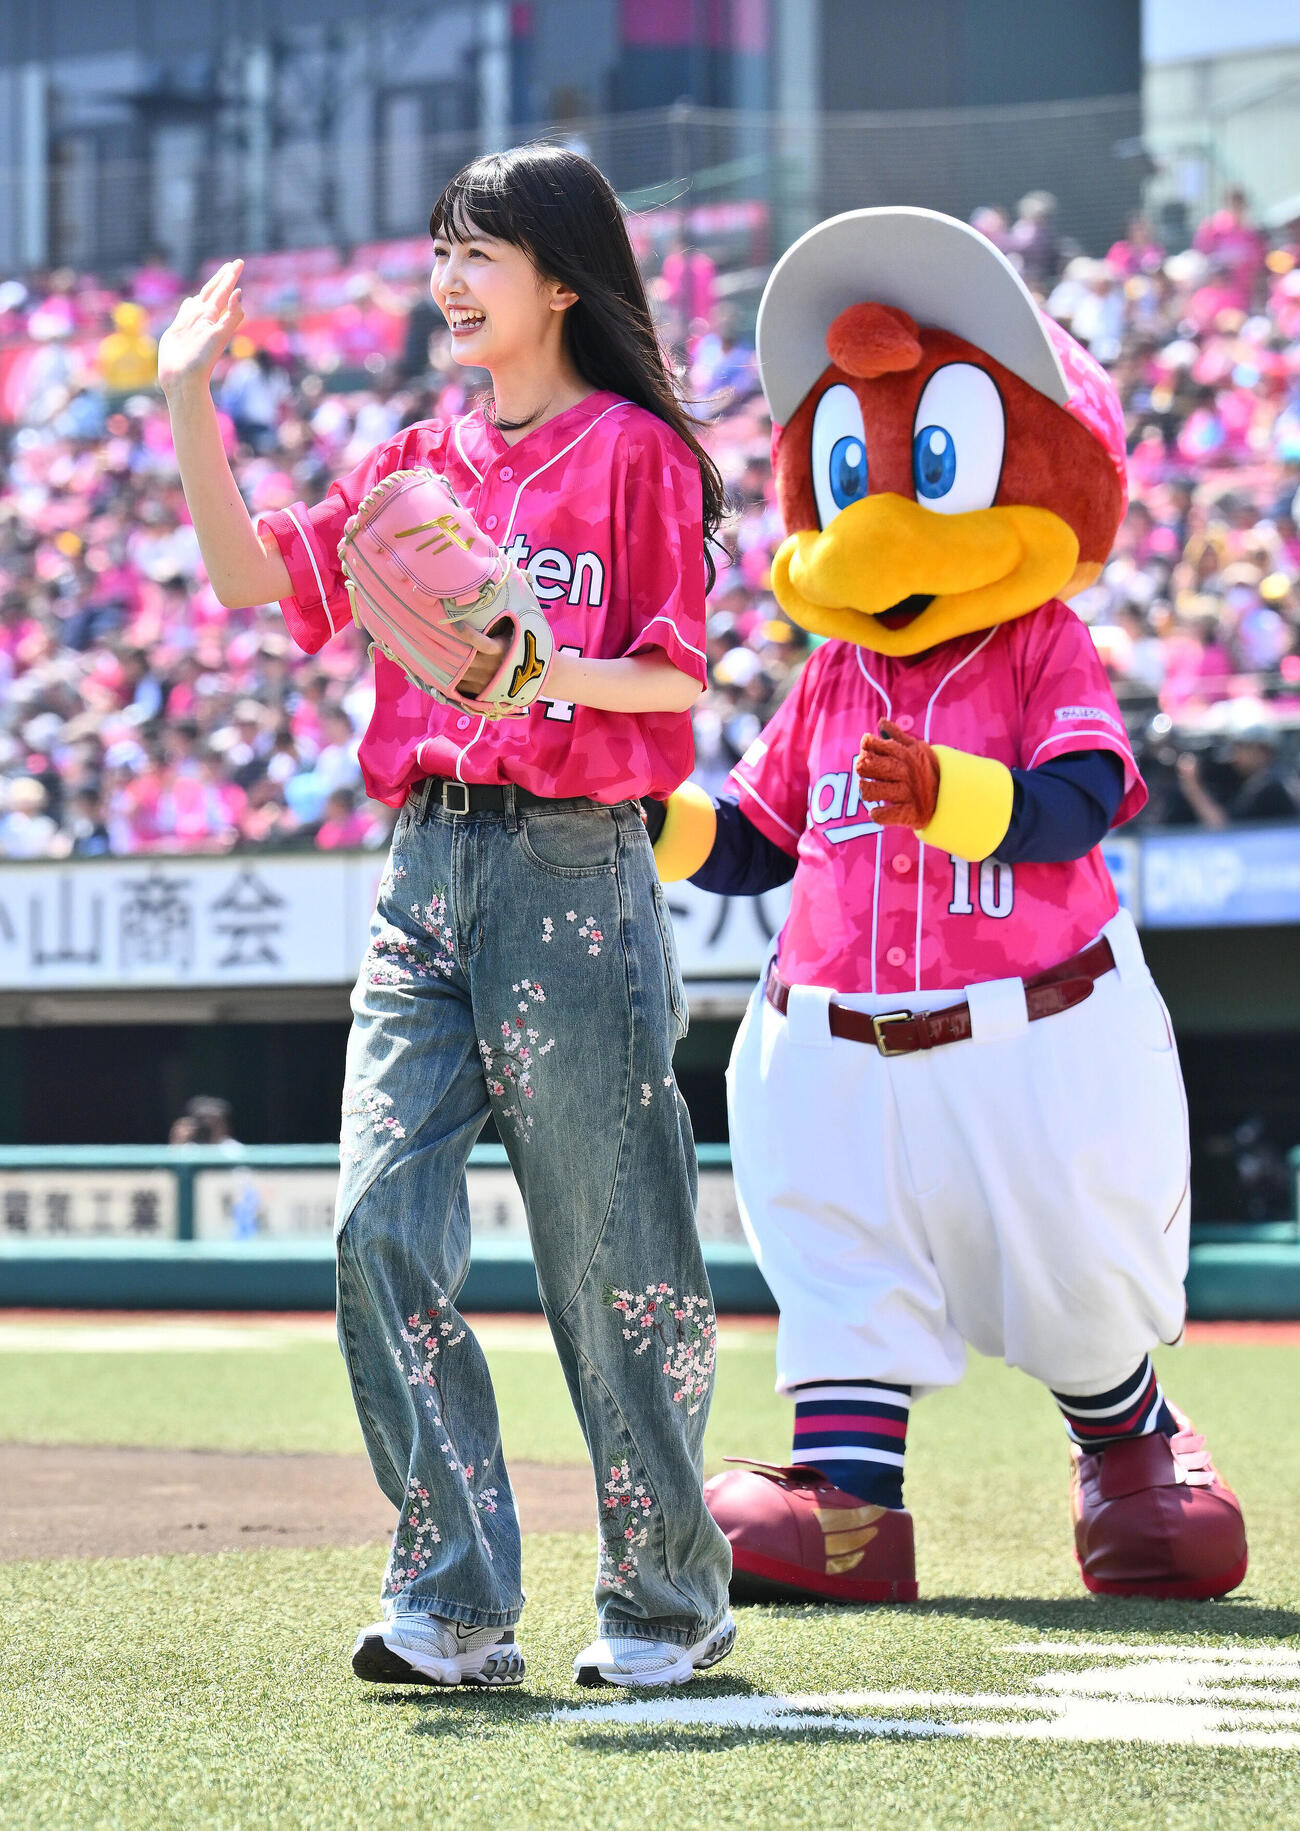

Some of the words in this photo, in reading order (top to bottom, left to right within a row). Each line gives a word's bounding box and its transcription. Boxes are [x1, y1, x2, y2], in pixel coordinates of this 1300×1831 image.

[501, 534, 605, 608] ten
[806, 754, 882, 830] ak
[0, 864, 286, 970] 山商会
[948, 853, 1014, 918] 10
